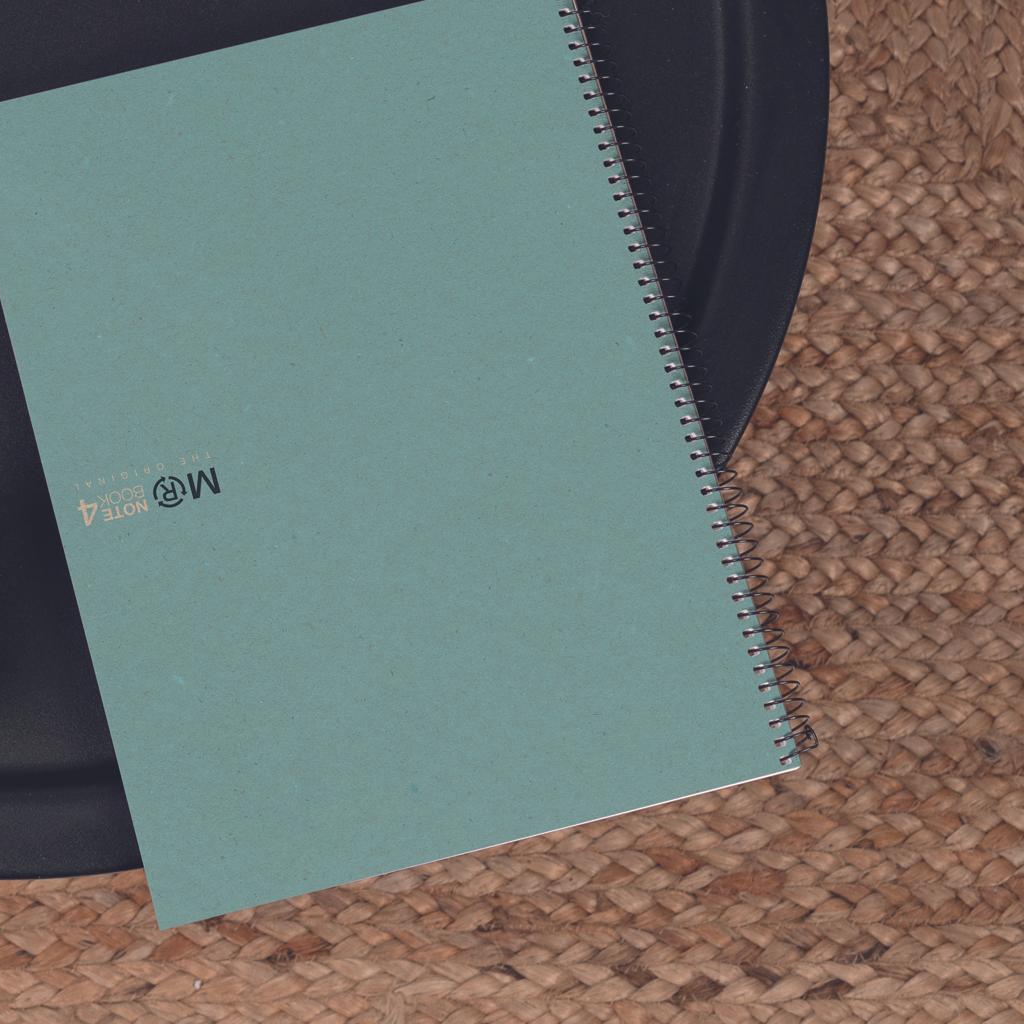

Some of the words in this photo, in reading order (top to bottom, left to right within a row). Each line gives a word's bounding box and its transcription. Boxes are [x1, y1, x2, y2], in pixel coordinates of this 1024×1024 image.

[180, 451, 213, 465] THE
[74, 462, 165, 491] ORIGINAL
[96, 485, 145, 507] BOOK
[77, 498, 98, 527] 4
[101, 498, 149, 522] NOTE
